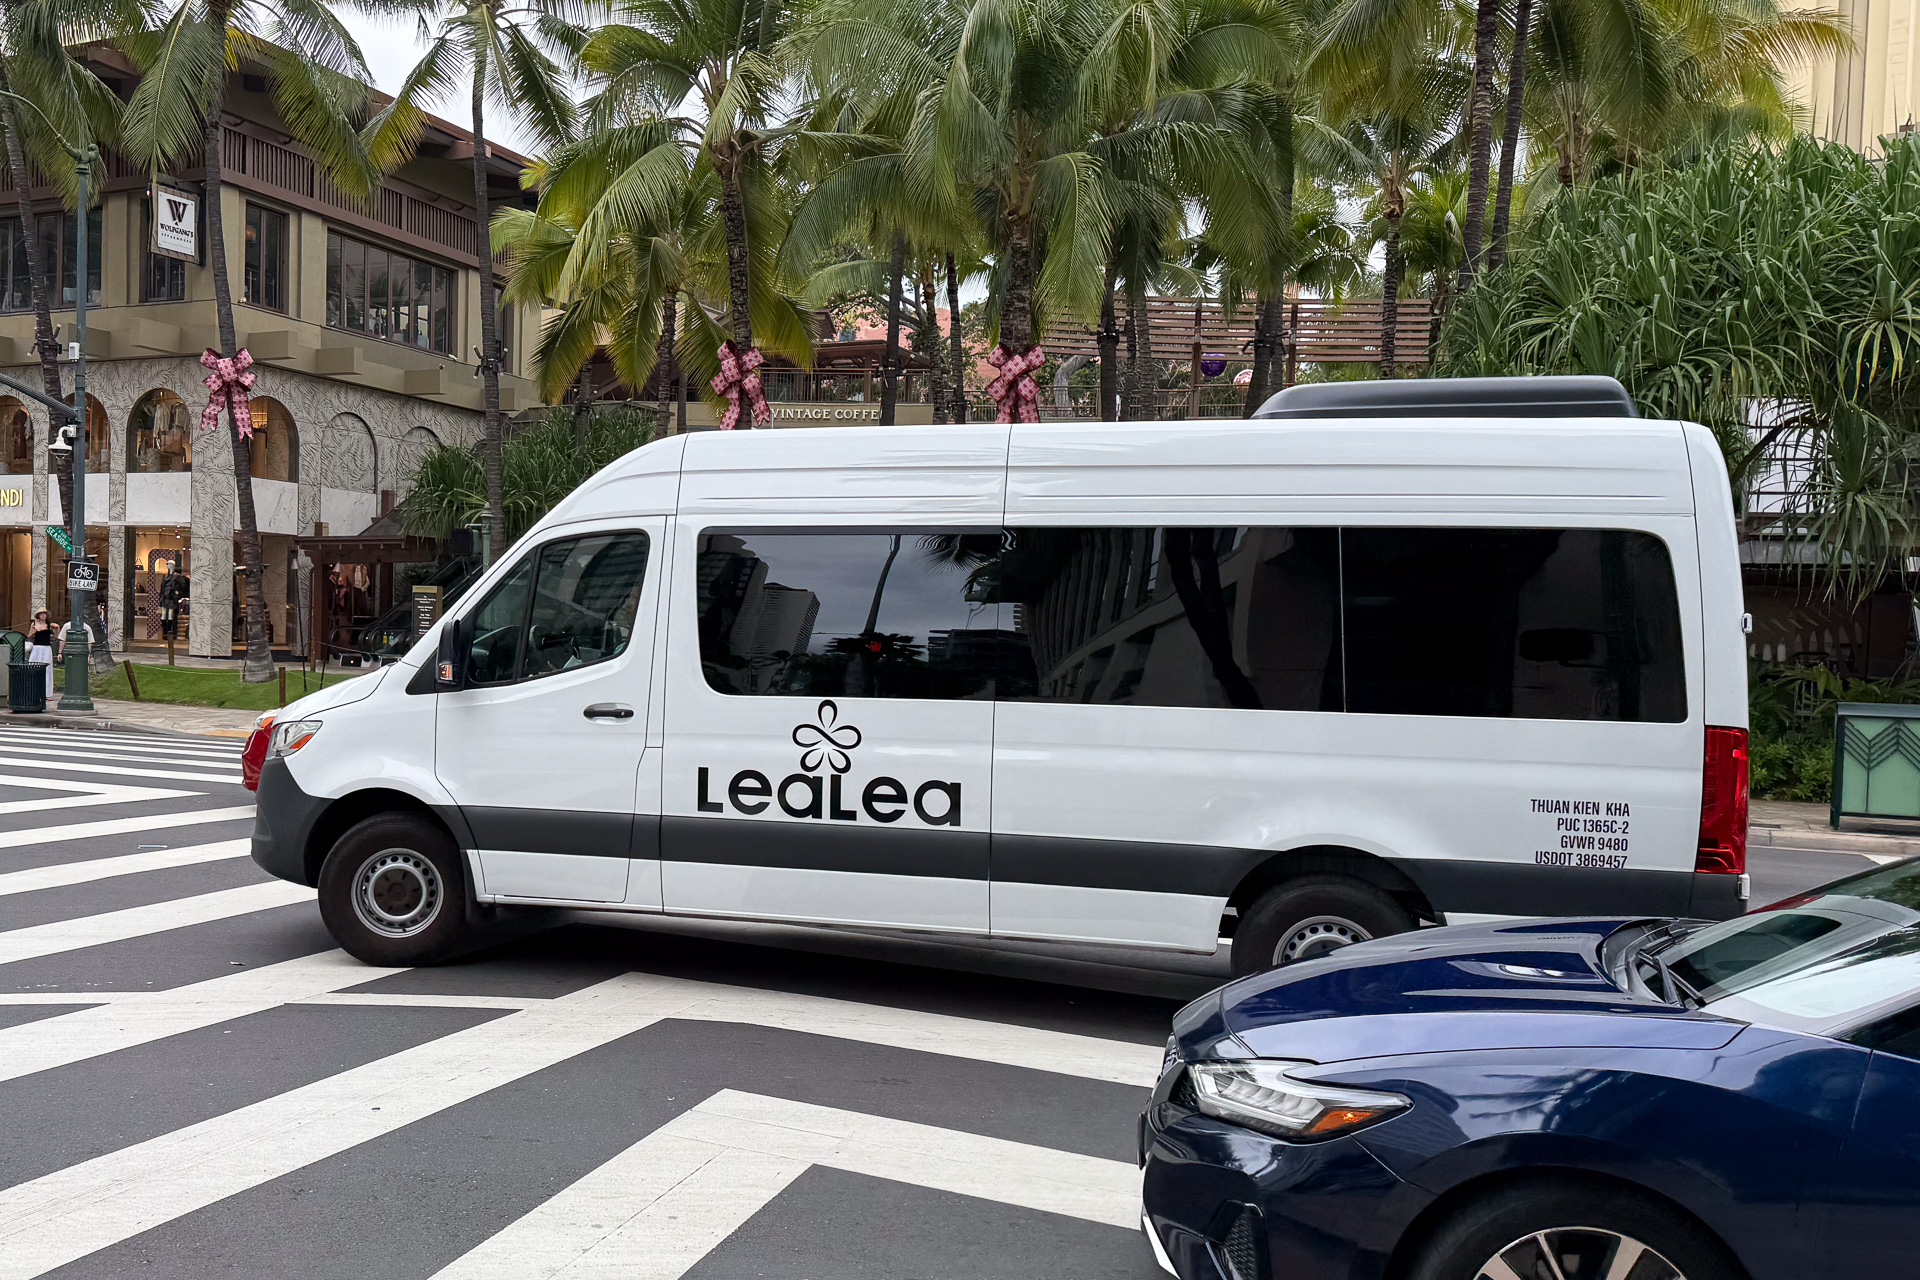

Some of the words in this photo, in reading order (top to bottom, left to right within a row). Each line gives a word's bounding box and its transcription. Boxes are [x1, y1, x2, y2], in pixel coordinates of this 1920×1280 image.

[771, 408, 831, 419] VINTAGE
[834, 408, 879, 420] COFFE
[46, 526, 68, 549] SEASIDE
[69, 579, 82, 588] BIKE
[82, 580, 96, 589] LANE
[1530, 799, 1570, 814] THUAN
[1573, 801, 1600, 816] KIEN
[1606, 802, 1630, 817] KHA
[1557, 818, 1580, 832] PUC
[1583, 819, 1629, 835] 1365C-2
[1560, 835, 1595, 850] GVWR
[1598, 838, 1628, 852] 9480
[1535, 851, 1573, 866] USDOT
[1575, 853, 1628, 869] 3869457
